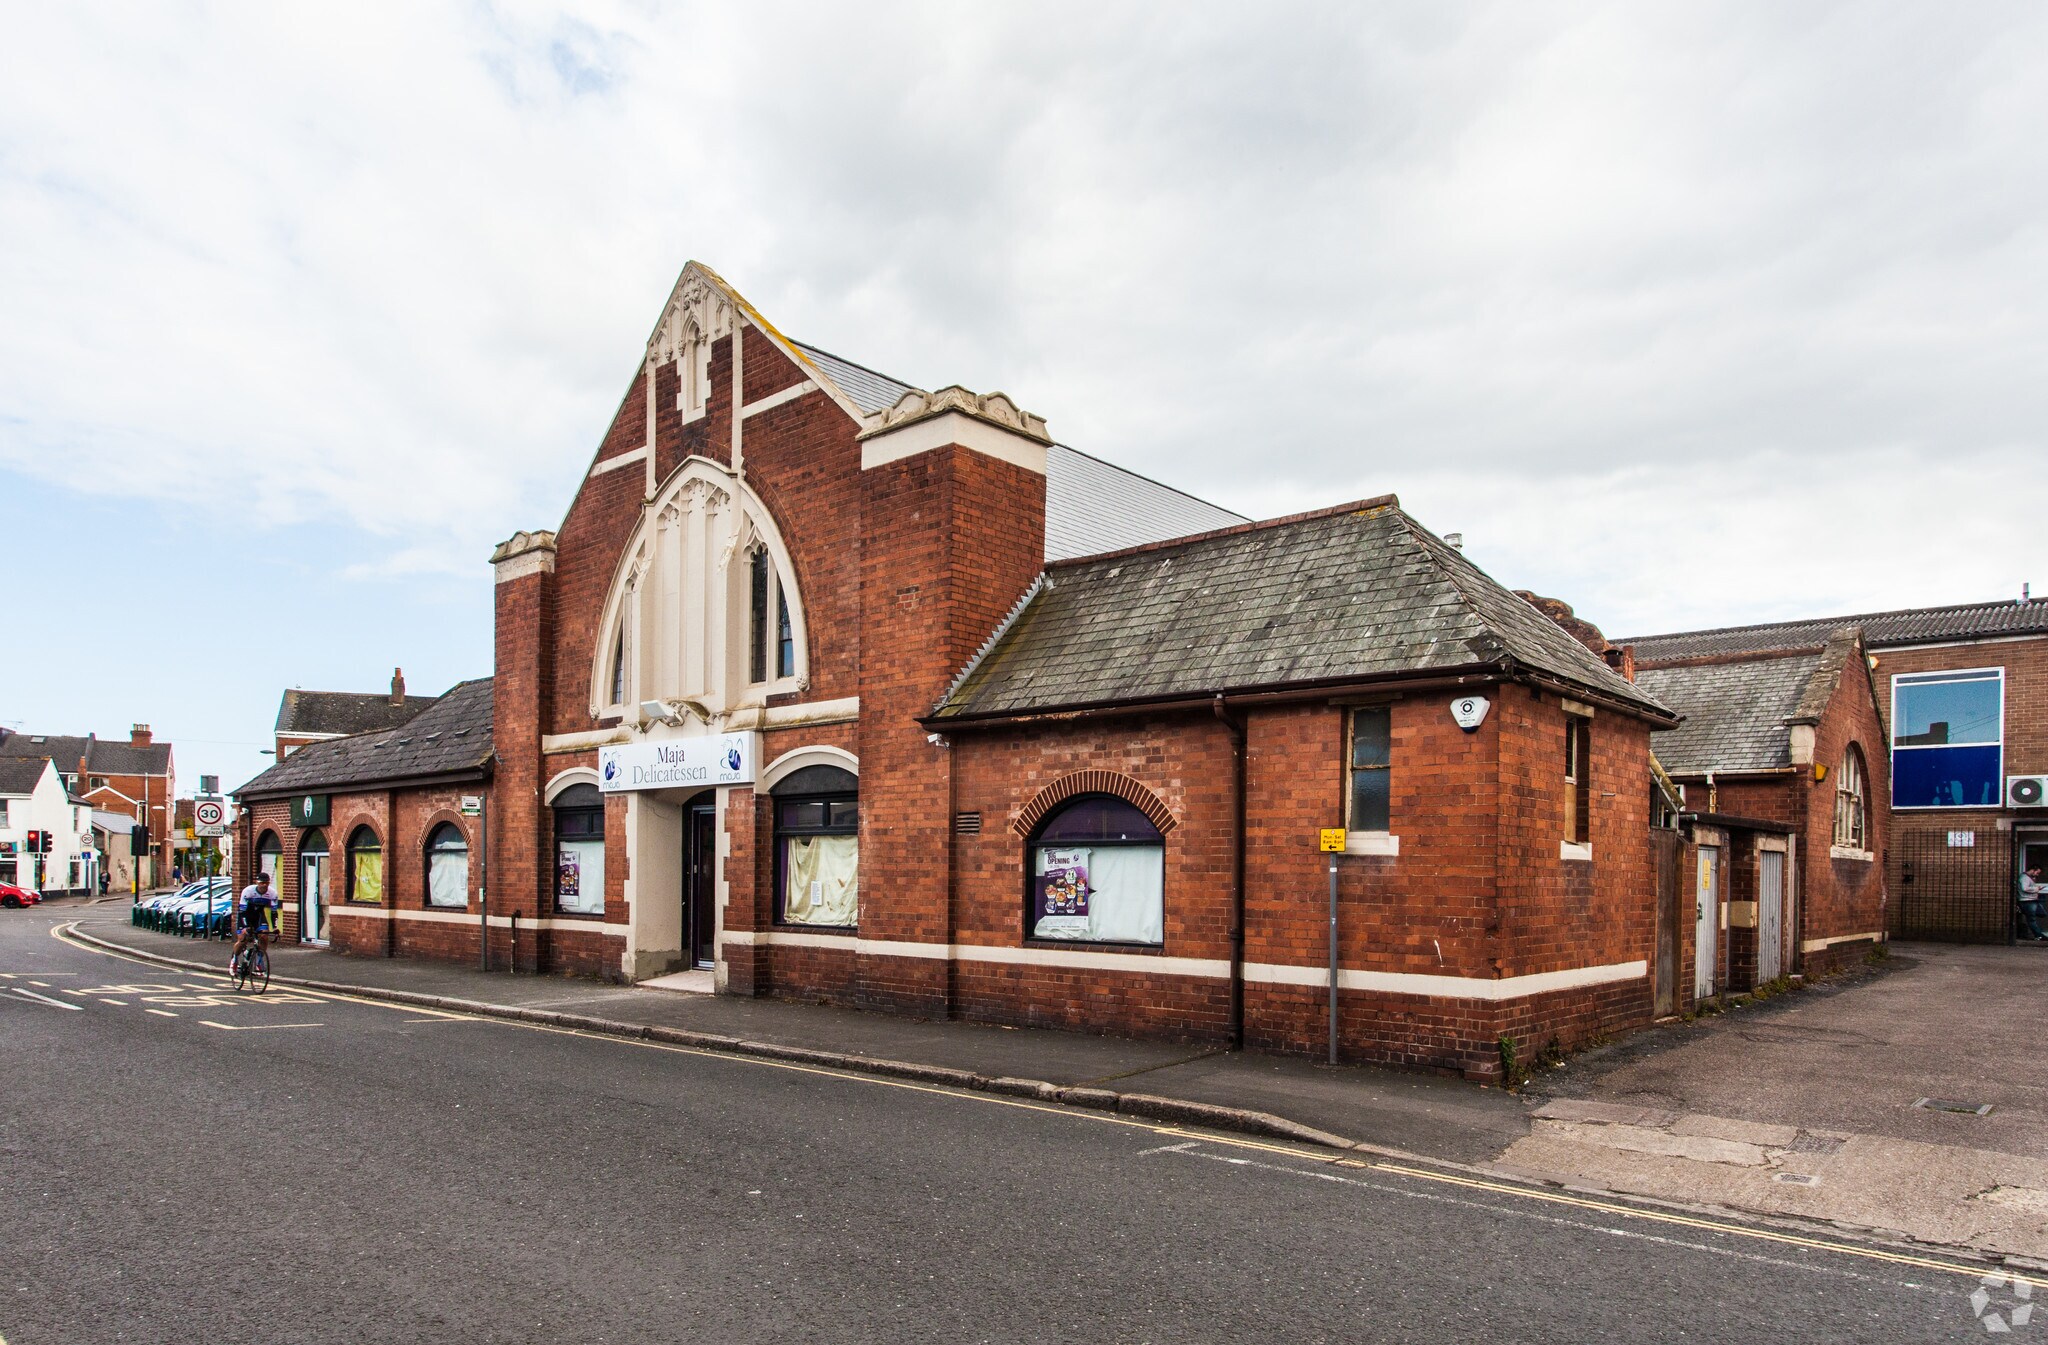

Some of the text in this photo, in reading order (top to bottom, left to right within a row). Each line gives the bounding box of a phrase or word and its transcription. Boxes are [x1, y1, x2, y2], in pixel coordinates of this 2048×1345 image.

[657, 745, 685, 767] Maja
[632, 762, 707, 784] Delicatessen
[200, 809, 219, 819] 30
[139, 993, 329, 1007] BUS
